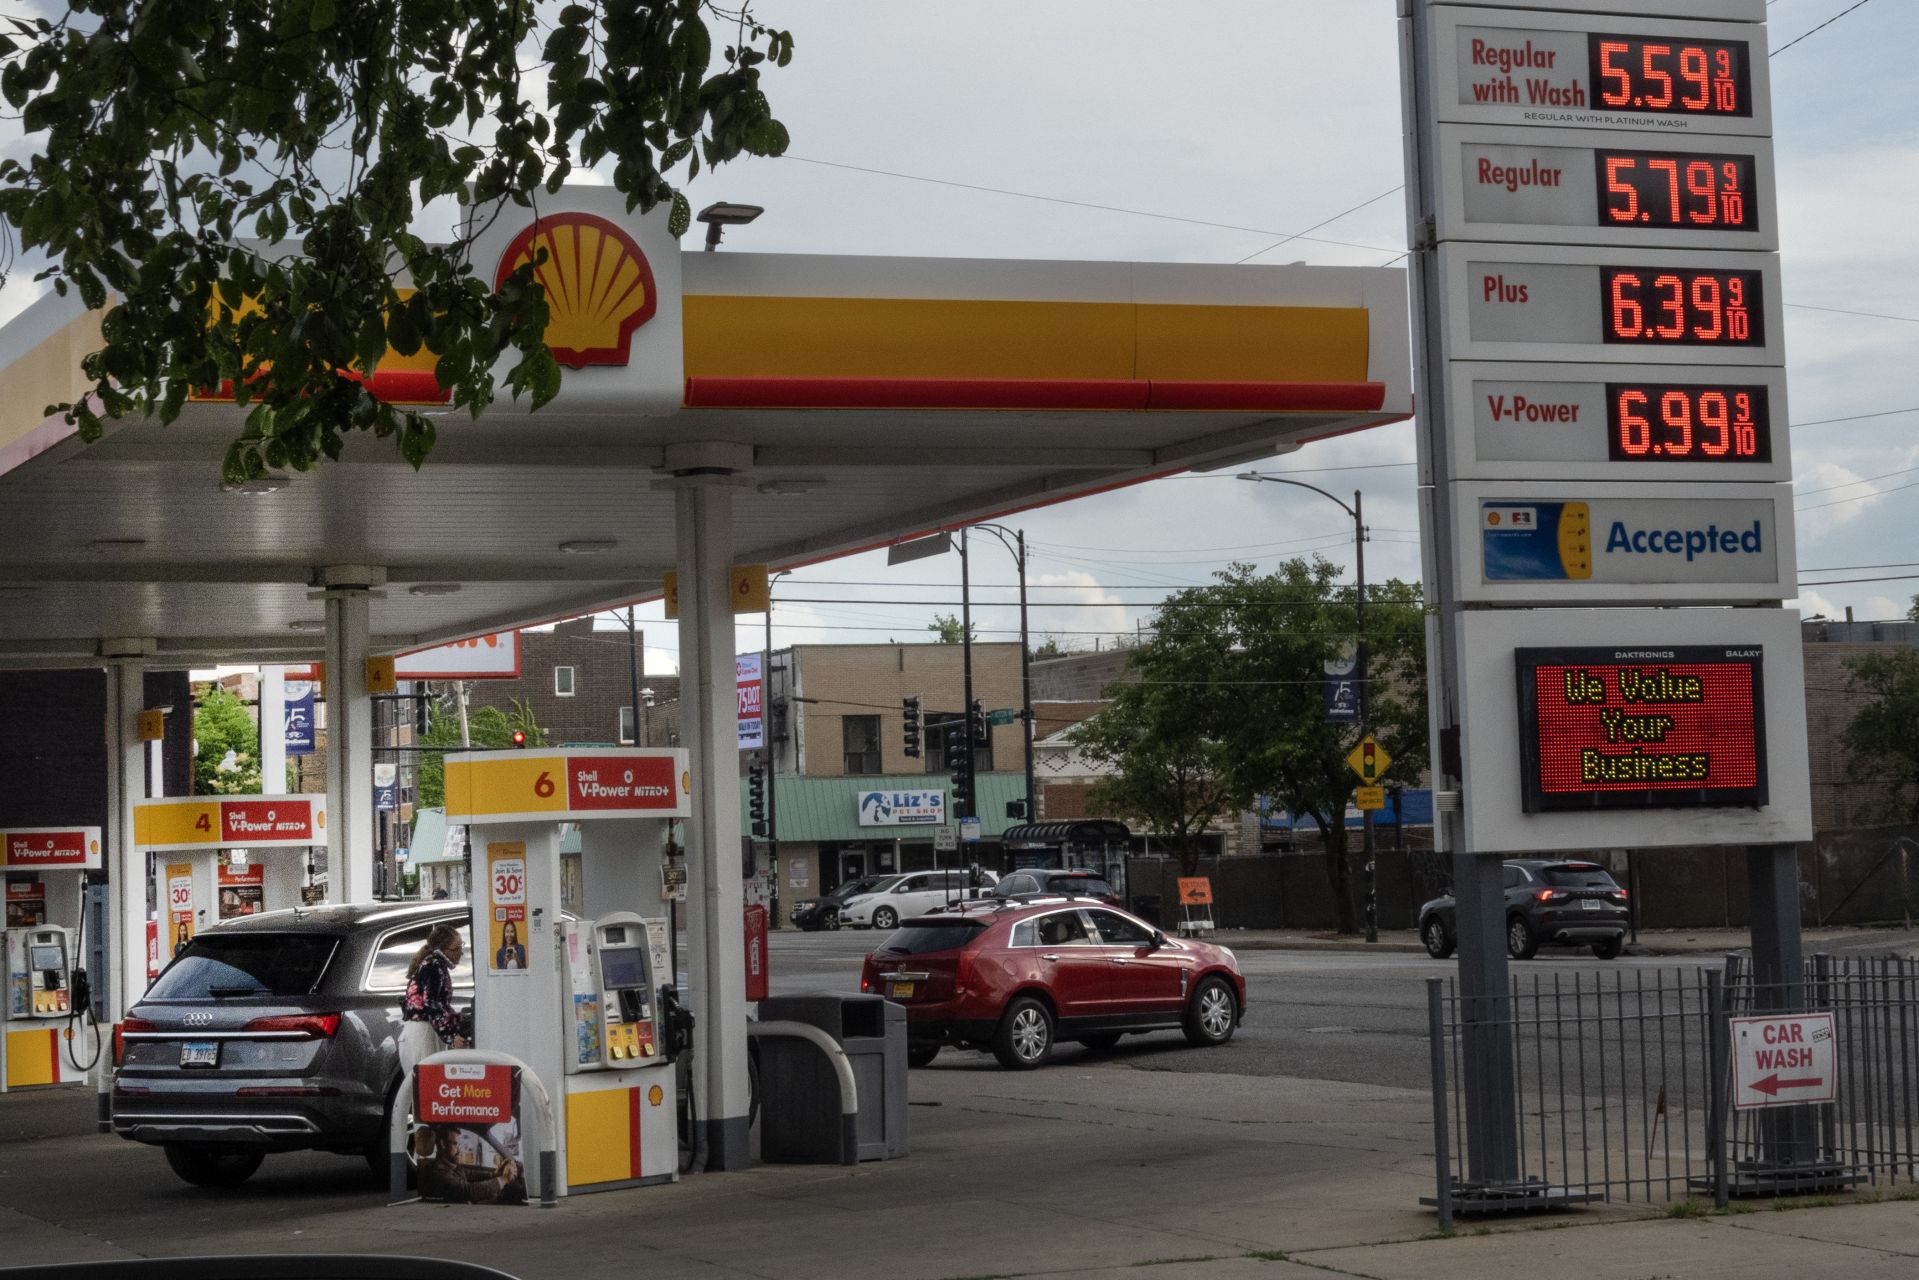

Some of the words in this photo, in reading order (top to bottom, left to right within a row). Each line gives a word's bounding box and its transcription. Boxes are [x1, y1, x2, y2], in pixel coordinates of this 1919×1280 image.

[1472, 39, 1555, 73] Regular
[1600, 42, 1710, 110] 5.59
[1472, 79, 1519, 105] with
[1527, 80, 1586, 107] Wash
[1524, 112, 1573, 122] REGULAR
[1575, 115, 1603, 123] WITH
[1605, 116, 1655, 126] PLATINUM
[1656, 119, 1688, 128] WASH
[1478, 158, 1562, 192] Regular
[1607, 158, 1717, 224] 5.79
[1484, 275, 1529, 303] Plus
[1612, 274, 1721, 339] 6.39
[1488, 395, 1579, 423] V-Power
[1619, 391, 1729, 455] 6.99
[1606, 520, 1762, 562] Accepted
[739, 578, 749, 595] 6
[1615, 651, 1675, 659] DAKTRONICS
[1725, 650, 1760, 658] GALAXY
[373, 670, 381, 682] 4
[1565, 672, 1602, 700] We
[1619, 671, 1700, 699] Value
[1602, 710, 1671, 740] Your
[577, 770, 597, 782] Shell
[1583, 750, 1707, 780] Business
[534, 771, 555, 798] 6
[579, 783, 629, 798] V-Power
[893, 793, 941, 807] Liz's
[195, 813, 211, 832] 4
[229, 812, 246, 821] Shell
[230, 820, 274, 832] V-Power
[13, 841, 28, 849] Shell
[14, 849, 51, 858] V-Power
[1763, 1023, 1804, 1045] CAR
[1755, 1047, 1813, 1070] WASH
[439, 1083, 461, 1098] Get
[463, 1084, 492, 1098] More
[432, 1100, 500, 1116] Performance
